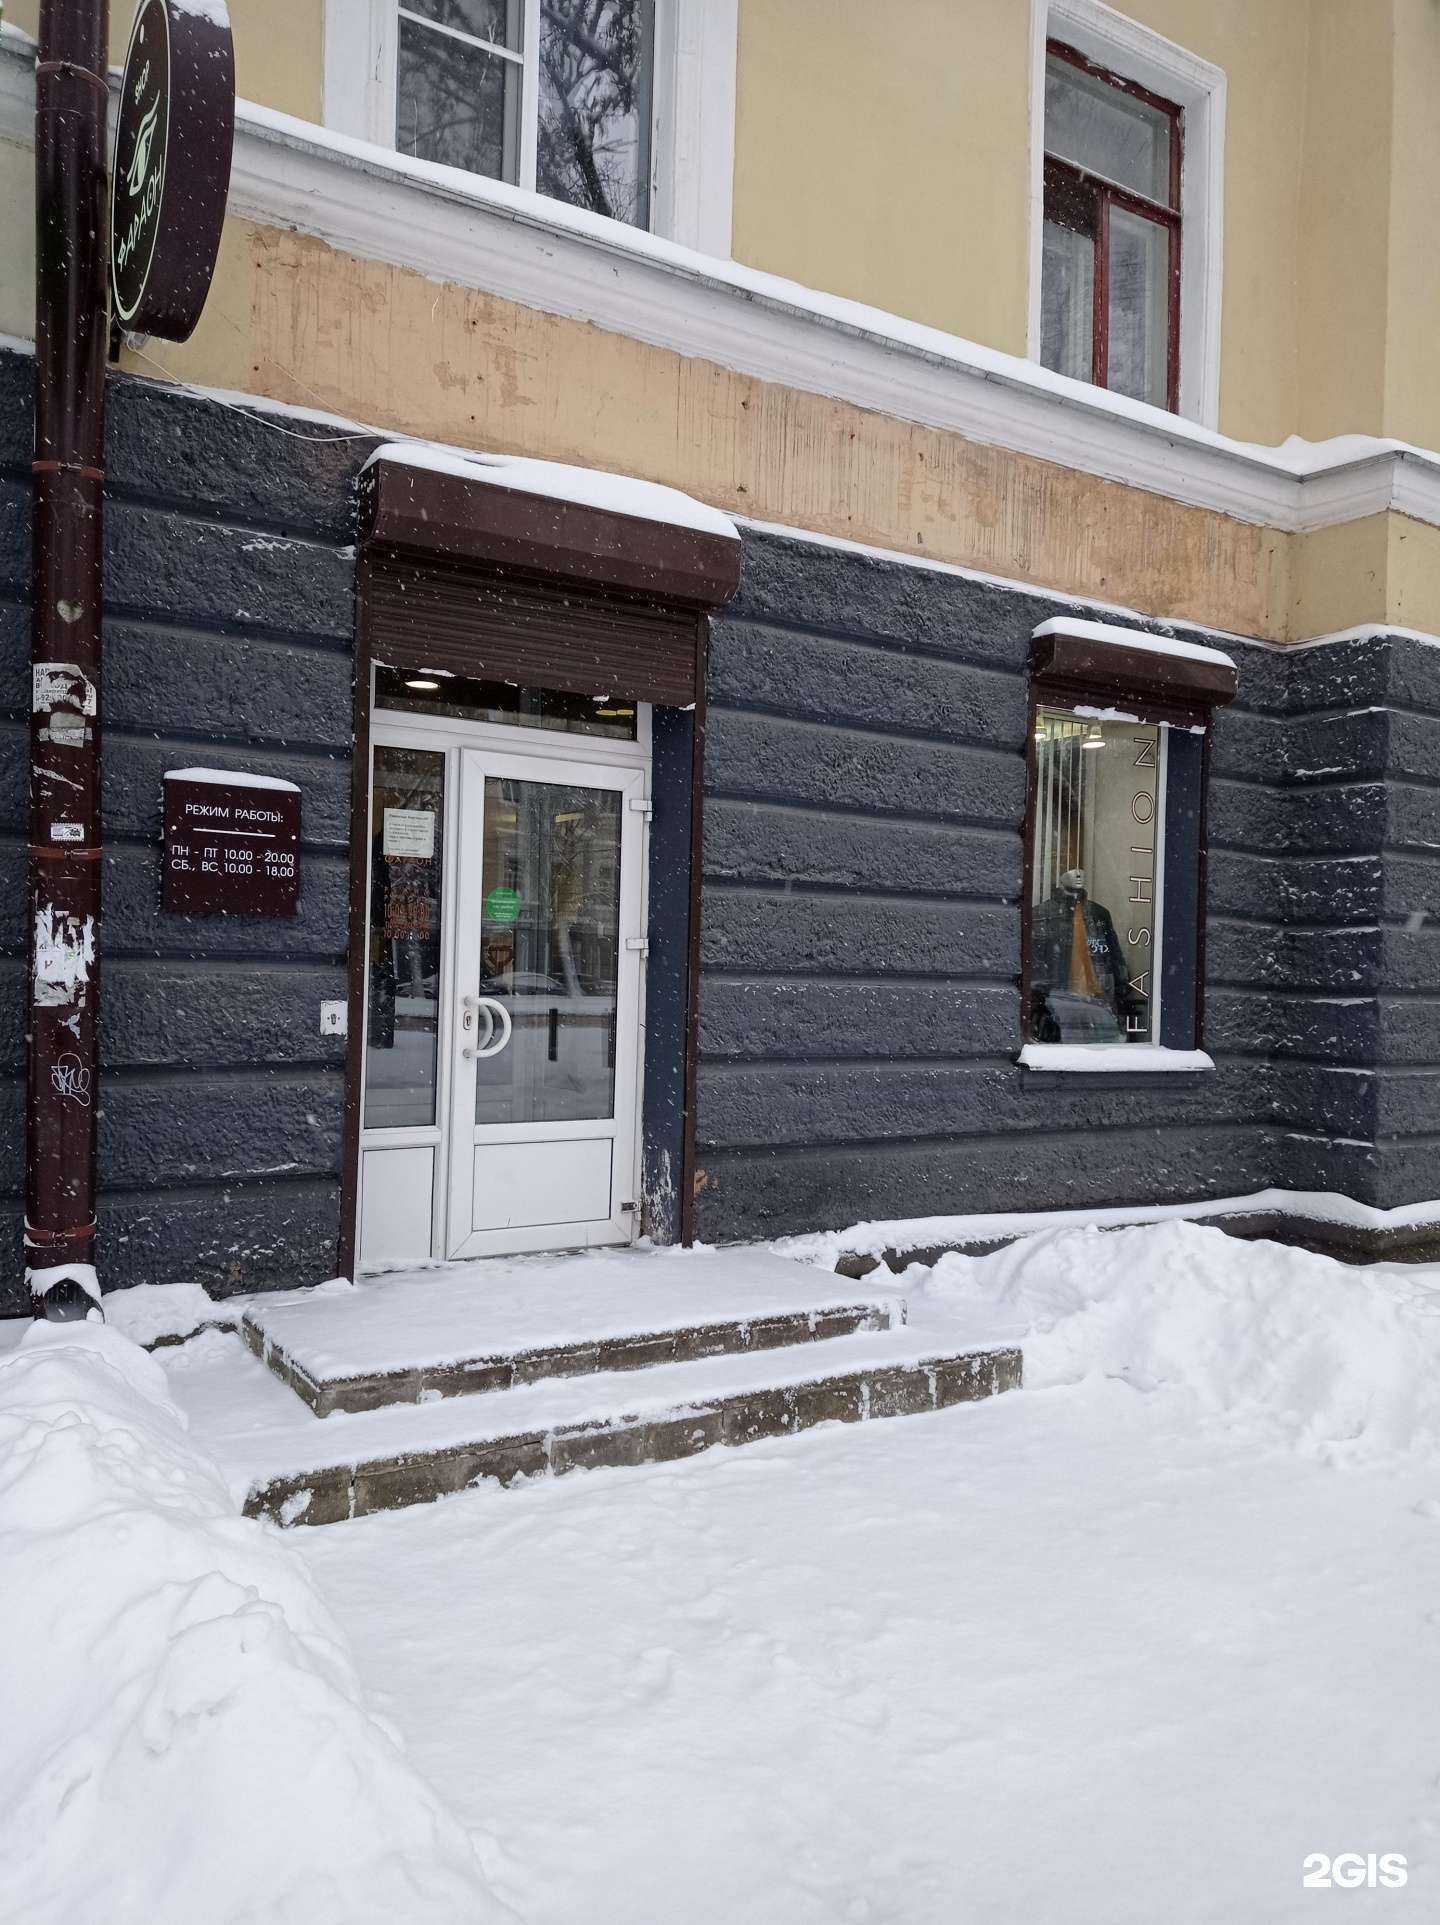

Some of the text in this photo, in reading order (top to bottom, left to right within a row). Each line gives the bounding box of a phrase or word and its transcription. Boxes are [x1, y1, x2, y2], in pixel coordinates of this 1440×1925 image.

[134, 59, 150, 105] SHOP
[117, 153, 162, 273] ФАРАОН
[185, 804, 283, 823] РЕЖИМ РАБОТЫ:
[172, 845, 189, 856] ПН
[204, 847, 218, 858] ПТ
[224, 849, 253, 860] 10.00
[264, 852, 294, 863] 20.00
[224, 862, 253, 874] 10.00
[265, 865, 294, 877] 18.00
[1126, 737, 1156, 1033] FASHION
